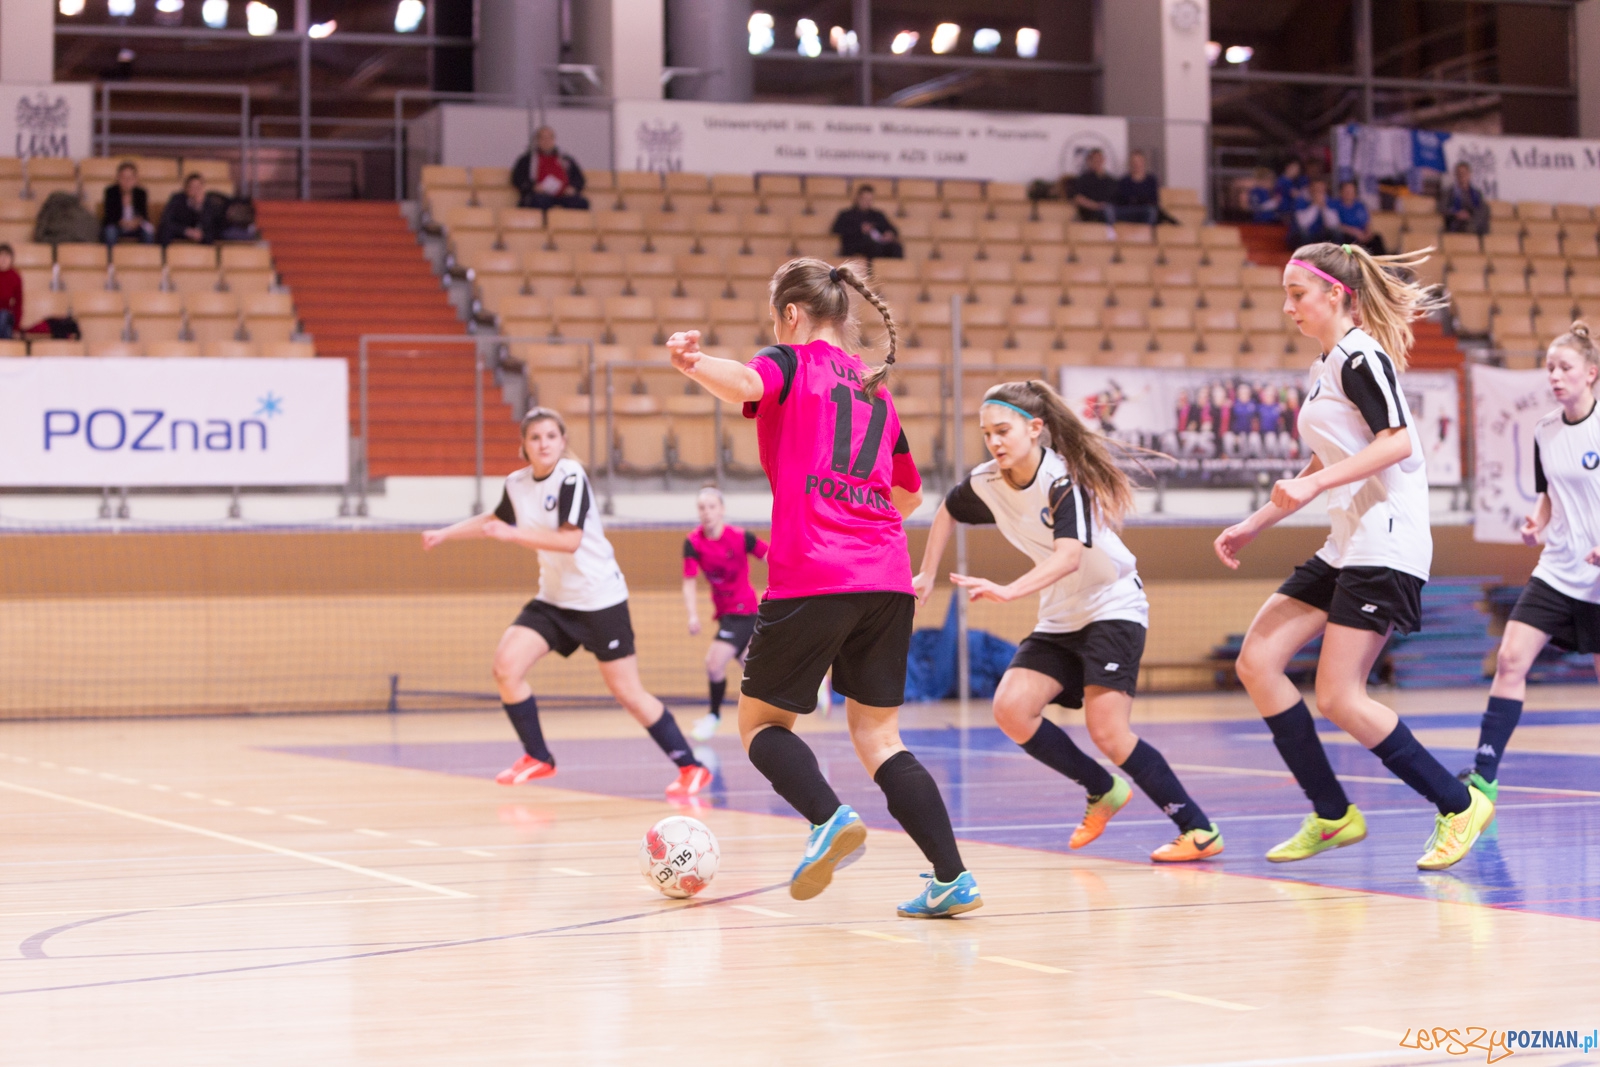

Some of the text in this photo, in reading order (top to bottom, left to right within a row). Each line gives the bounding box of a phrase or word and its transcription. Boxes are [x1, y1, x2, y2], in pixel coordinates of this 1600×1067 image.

[1505, 146, 1576, 169] Adam
[43, 409, 267, 451] POZnan
[831, 382, 888, 481] 17
